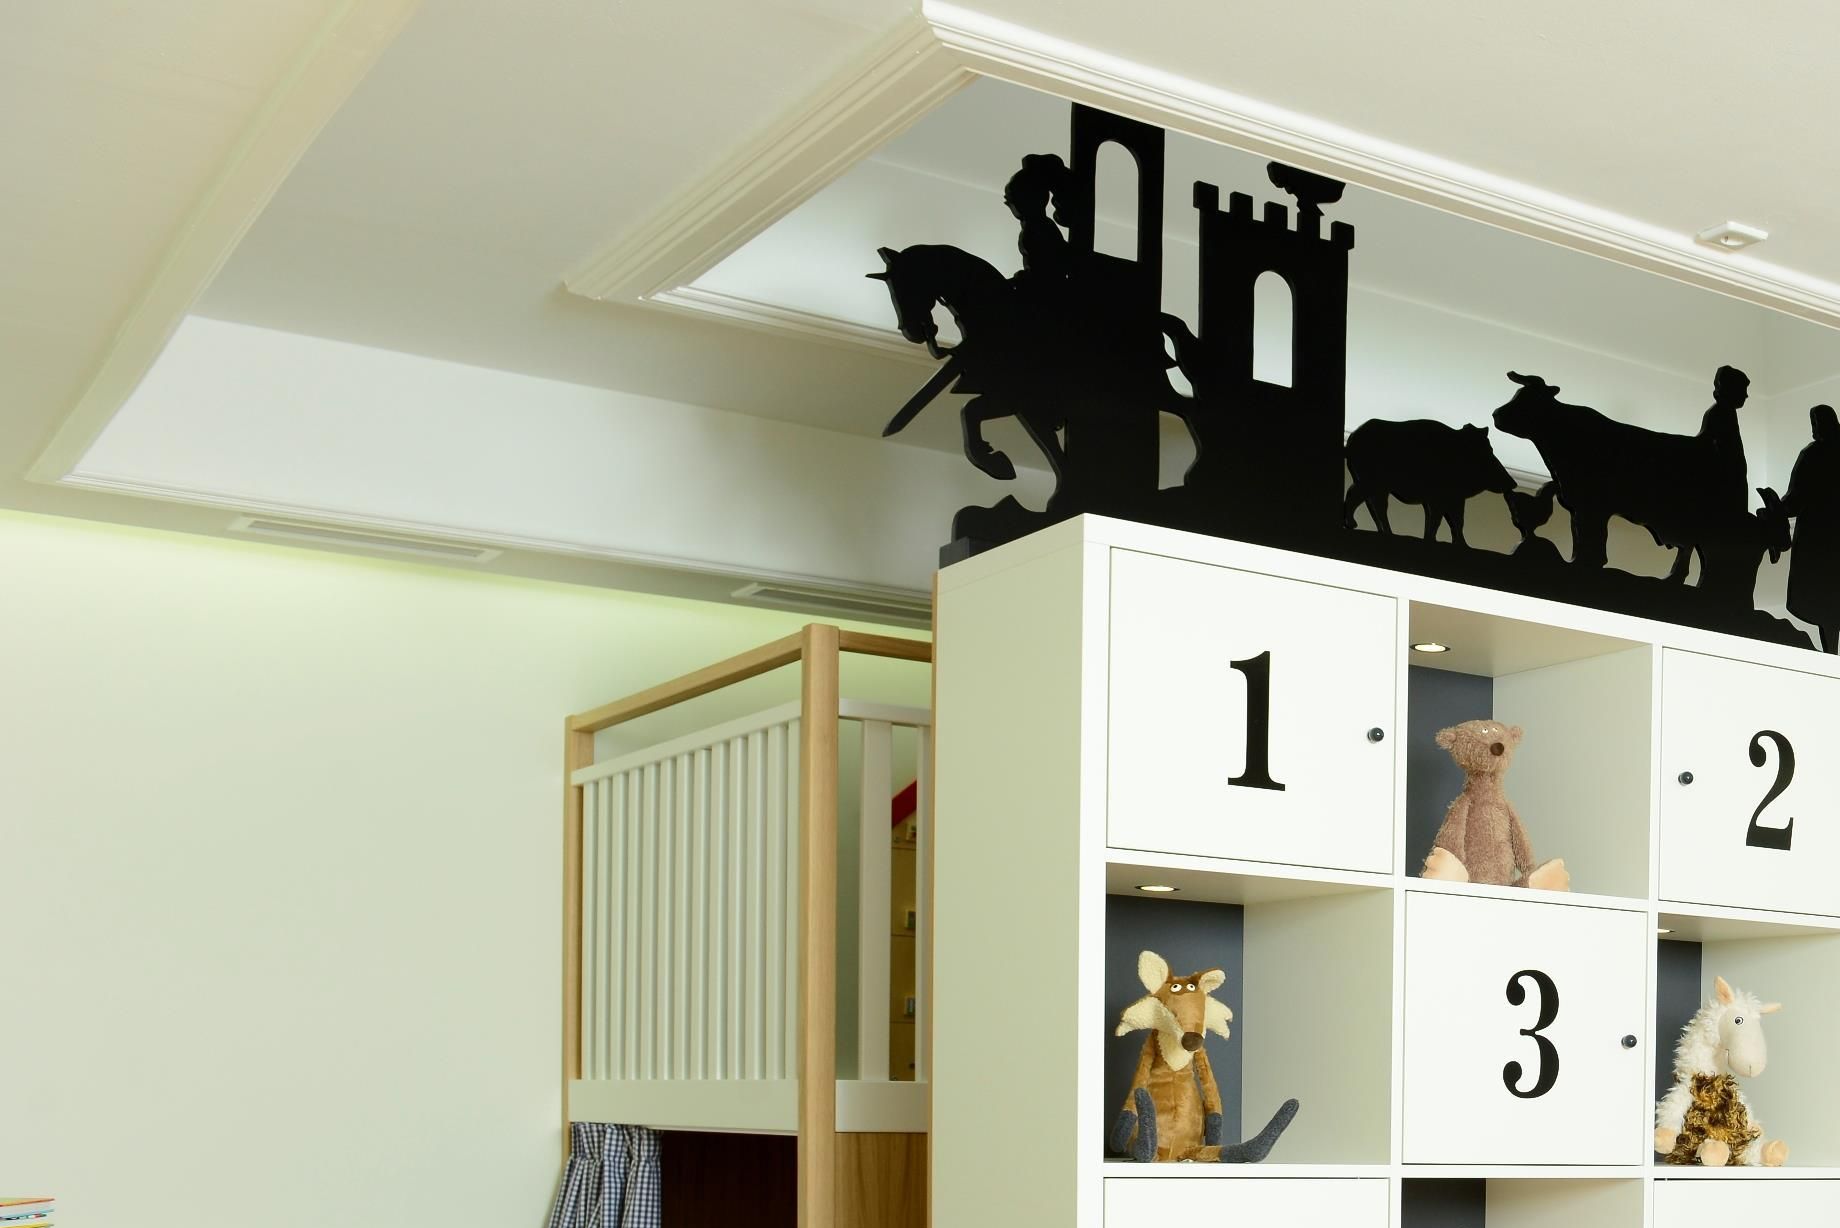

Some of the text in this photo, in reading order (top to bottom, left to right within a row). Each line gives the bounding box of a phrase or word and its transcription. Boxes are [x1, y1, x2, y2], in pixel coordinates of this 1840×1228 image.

[1227, 650, 1286, 792] 1
[1745, 729, 1796, 851] 2
[1502, 969, 1560, 1099] 3
